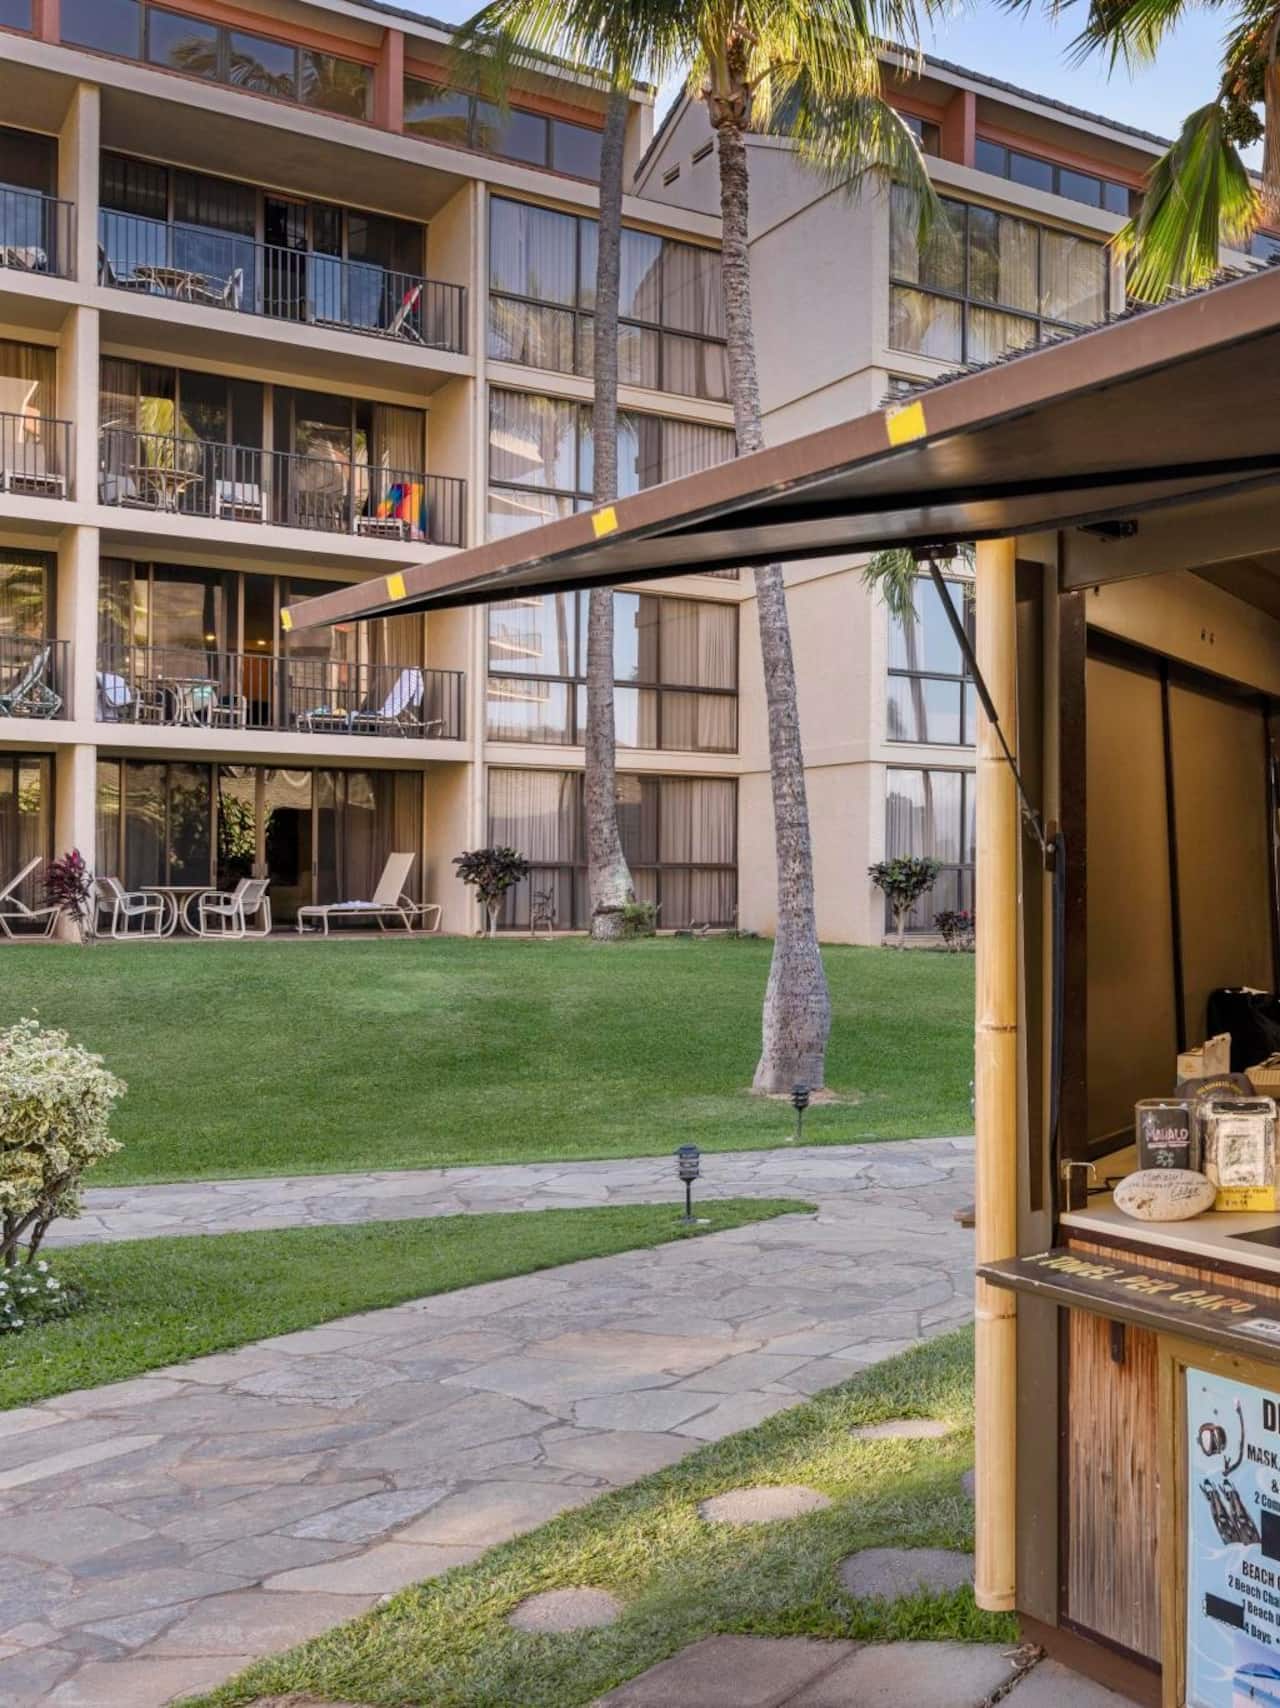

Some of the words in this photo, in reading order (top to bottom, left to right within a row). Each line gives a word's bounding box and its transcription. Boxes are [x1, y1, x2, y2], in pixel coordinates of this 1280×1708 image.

[1039, 1255, 1124, 1280] TOWEL
[1113, 1274, 1179, 1295] PER
[1169, 1289, 1257, 1314] CARD
[1254, 1491, 1260, 1504] 2
[1271, 1478, 1280, 1494] &
[1242, 1560, 1275, 1588] BEACH
[1228, 1574, 1234, 1588] 2
[1234, 1576, 1261, 1599] Beach
[1247, 1600, 1274, 1624] Beach
[1243, 1622, 1249, 1635] 4
[1251, 1624, 1272, 1645] Days
